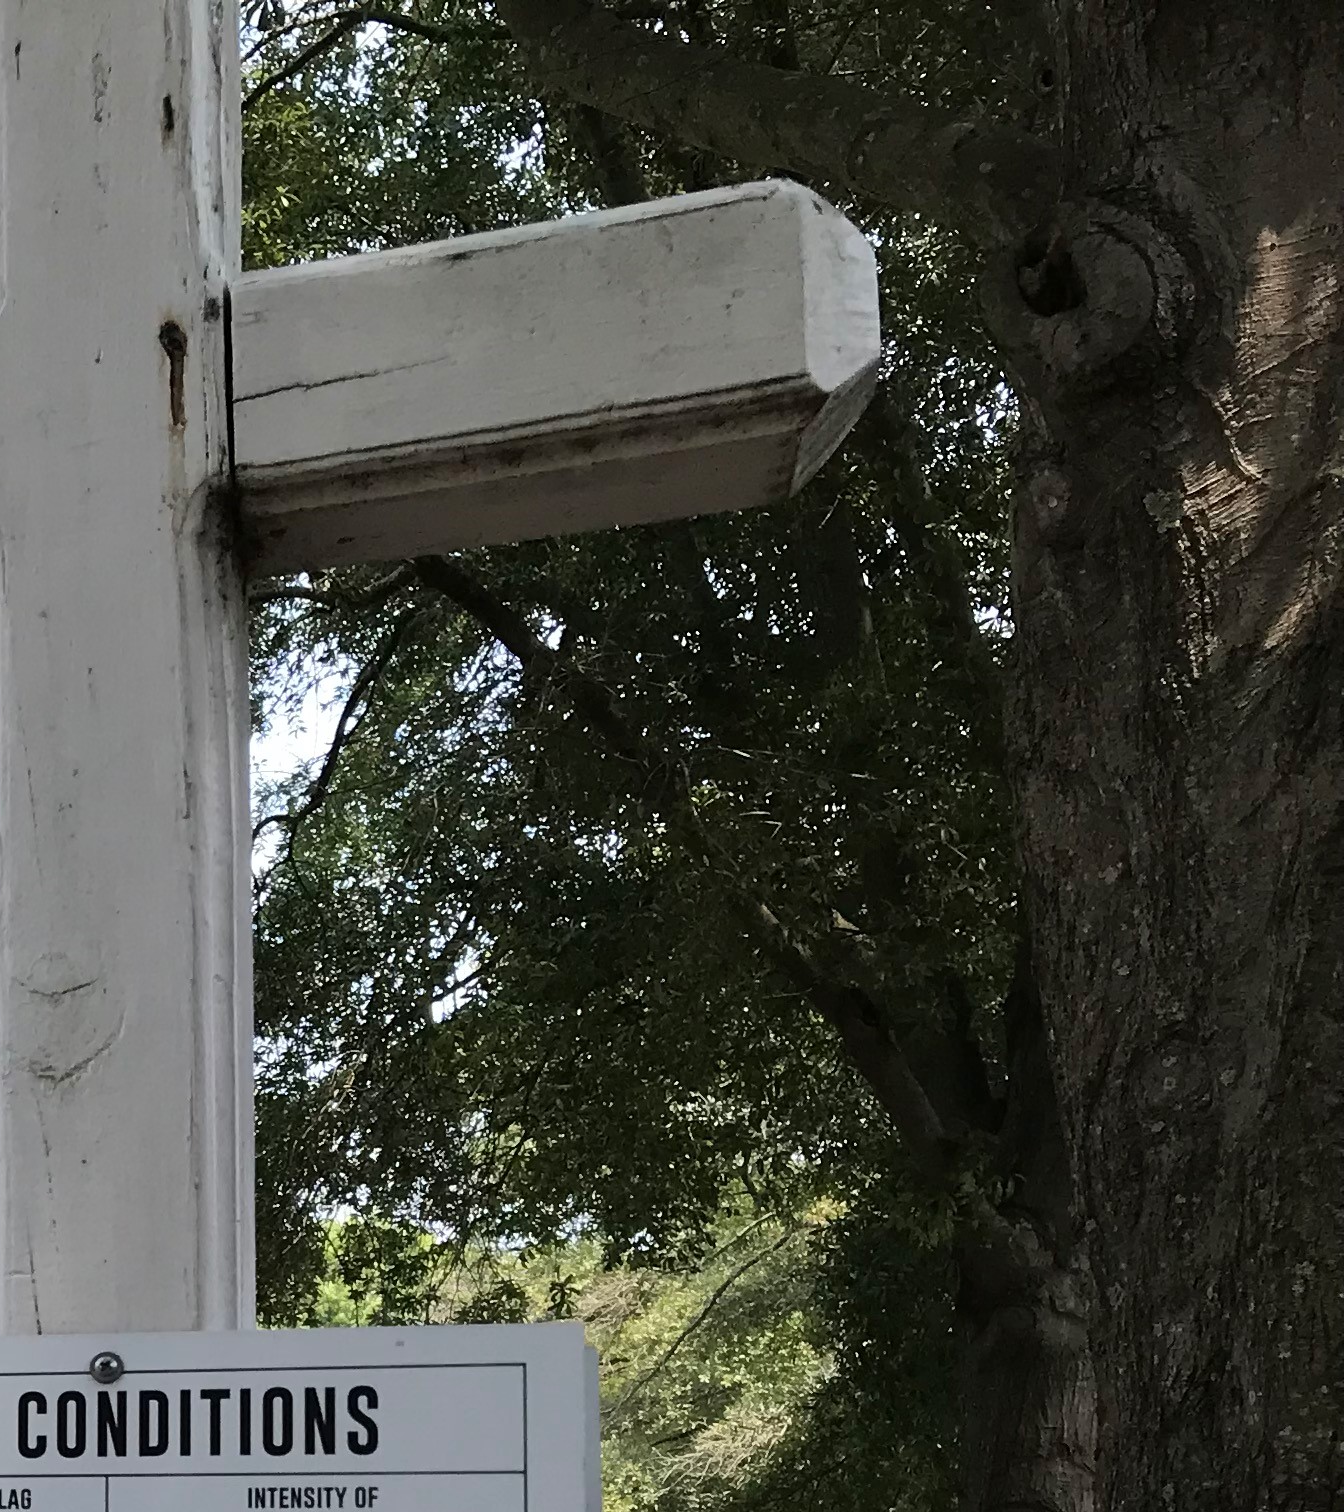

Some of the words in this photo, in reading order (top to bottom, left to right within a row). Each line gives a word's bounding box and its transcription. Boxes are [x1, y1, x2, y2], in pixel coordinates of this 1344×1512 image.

[18, 1385, 379, 1460] CONDITIONS
[248, 1487, 347, 1509] INTENSITY
[355, 1486, 379, 1508] OF
